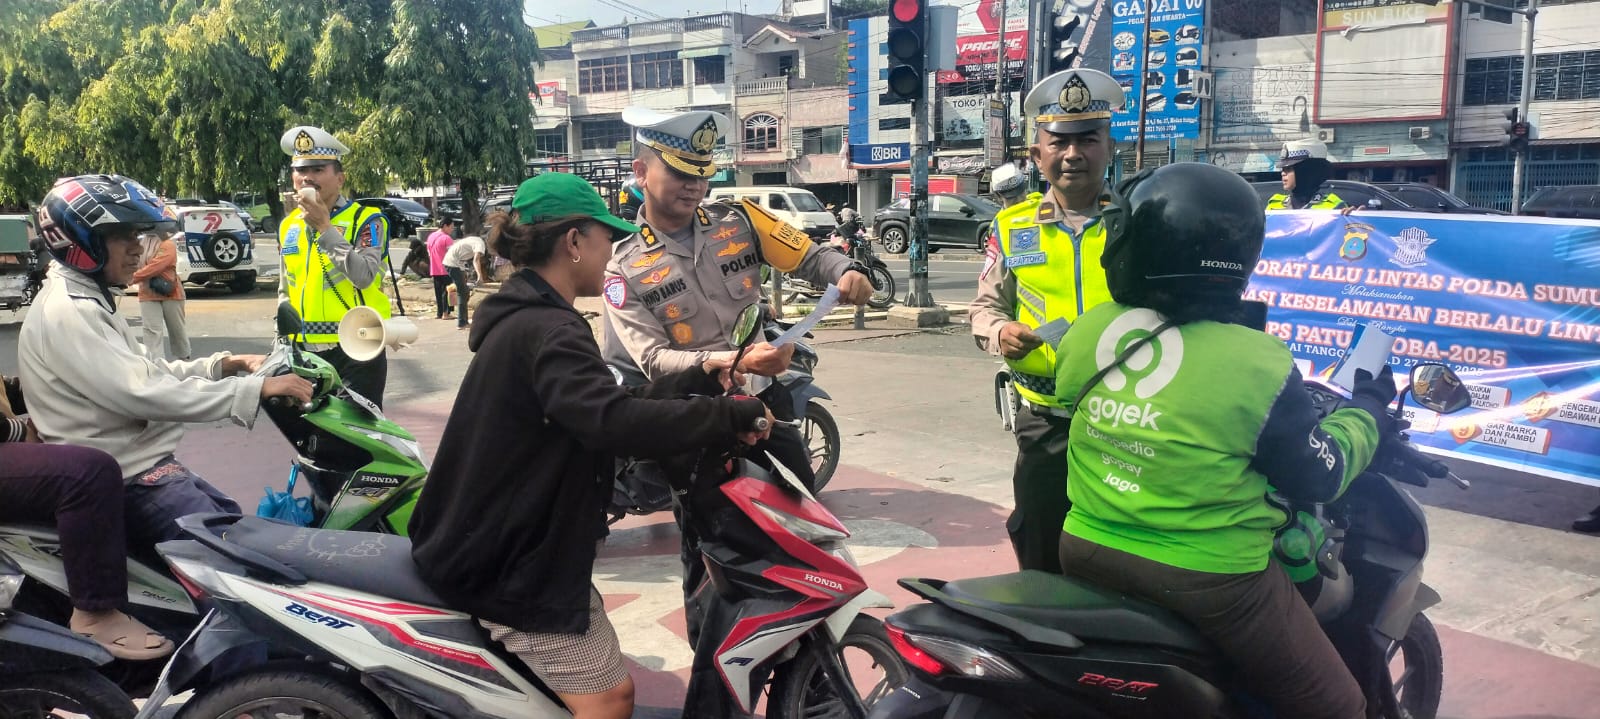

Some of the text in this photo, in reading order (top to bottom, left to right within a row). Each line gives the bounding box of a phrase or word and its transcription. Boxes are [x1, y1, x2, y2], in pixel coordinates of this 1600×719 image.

[1342, 5, 1425, 25] SUN BIKE
[953, 100, 977, 108] TOKO
[883, 147, 901, 160] BRI
[721, 253, 748, 276] POLRI
[1200, 260, 1243, 271] HONDA
[660, 278, 687, 299] BARUS
[1308, 264, 1363, 285] LALU
[1365, 268, 1445, 292] LINTAS
[1446, 276, 1530, 302] POLDA
[1278, 292, 1432, 324] KESELAMATAN
[1433, 308, 1545, 337] BERLALU
[1264, 321, 1507, 368] PS PATU OBA-2025
[1304, 345, 1346, 358] TANGG
[1403, 359, 1418, 367] 27
[1088, 396, 1162, 431] gojek
[1559, 410, 1597, 423] DIBAWAH
[1484, 429, 1536, 443] DAN RAMBU
[1506, 425, 1537, 436] MARKA
[1483, 436, 1507, 445] LALIN
[1101, 453, 1142, 477] gopay
[361, 475, 400, 485] HONDA
[804, 573, 843, 591] HONDA
